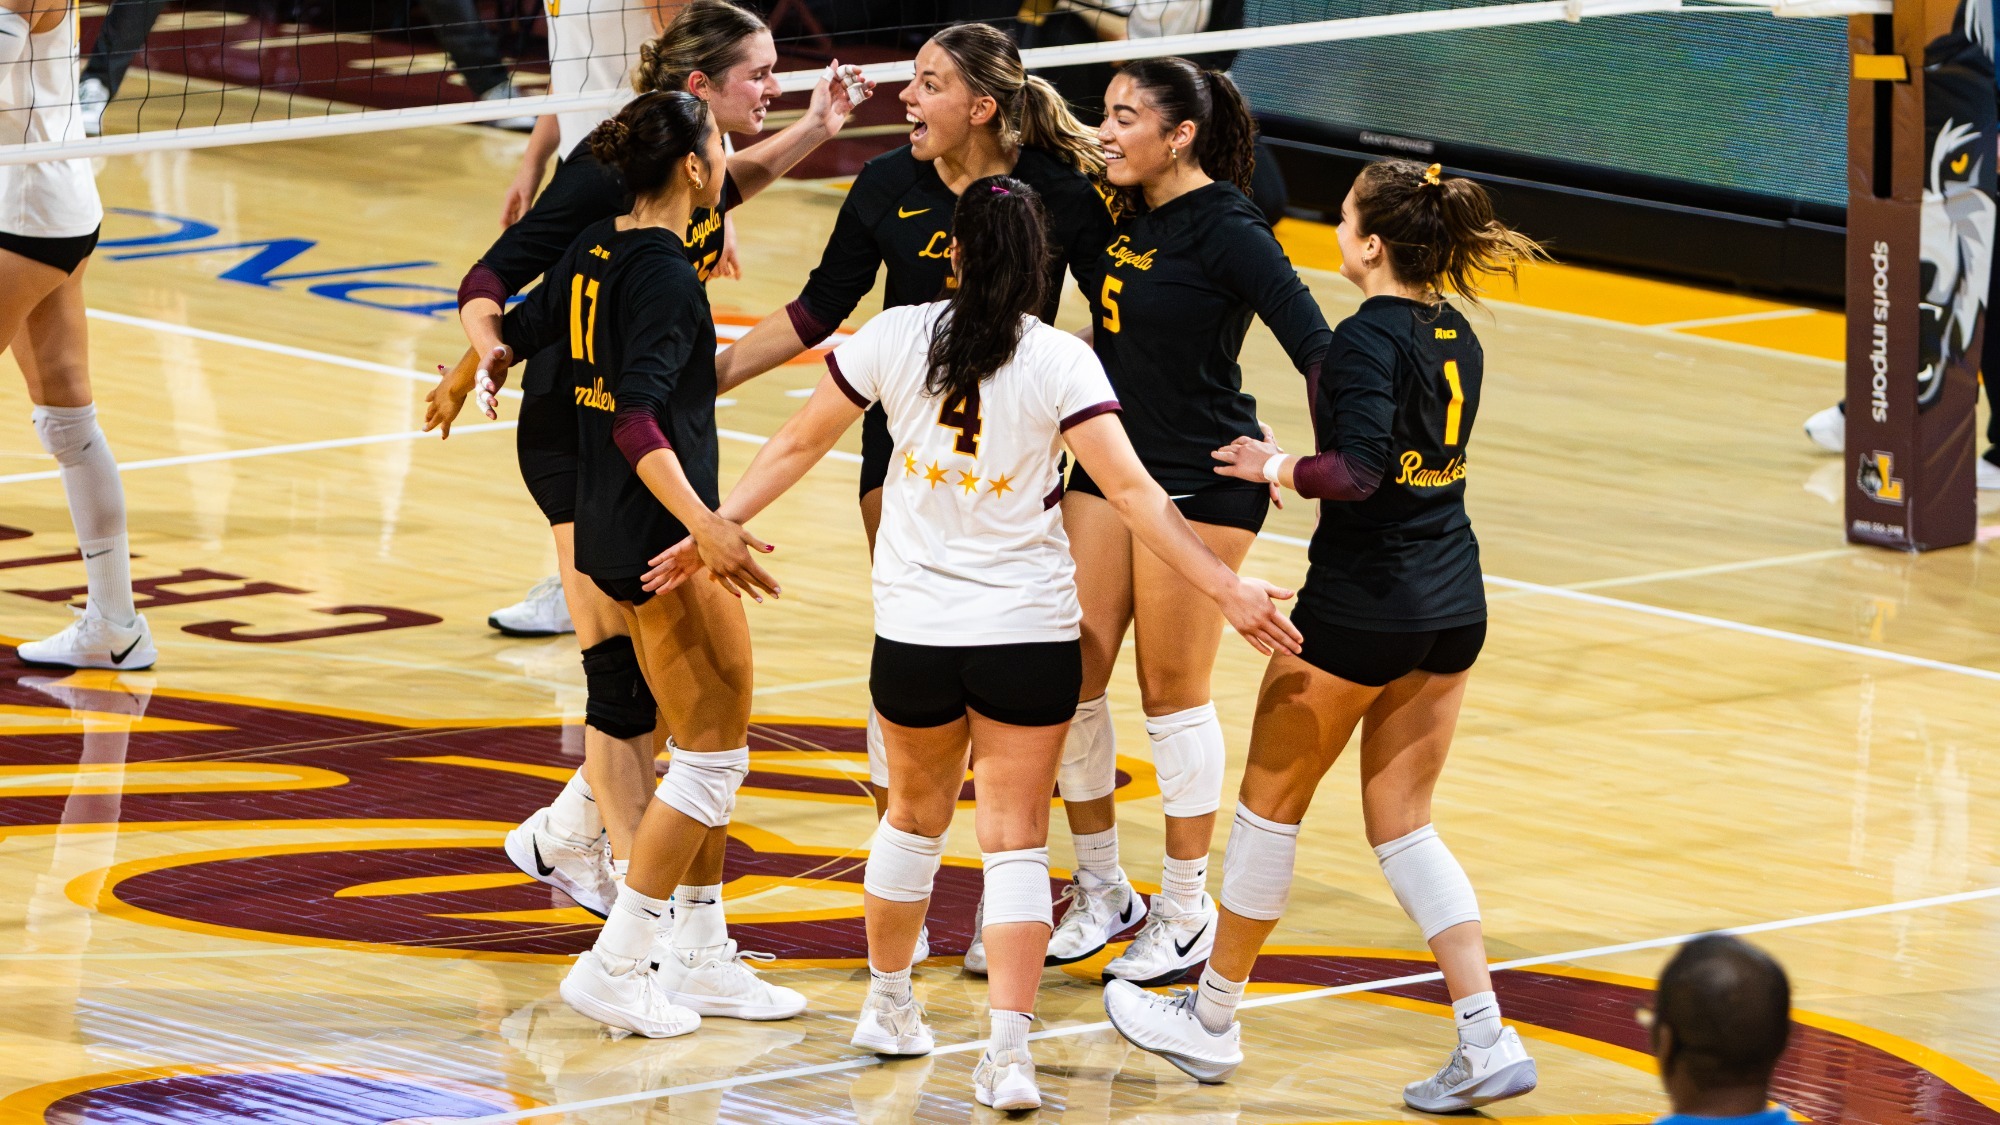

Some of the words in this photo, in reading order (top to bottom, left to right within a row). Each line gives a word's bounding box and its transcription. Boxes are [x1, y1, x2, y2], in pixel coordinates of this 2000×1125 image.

[1106, 235, 1157, 271] Loyola
[1870, 240, 1891, 321] sports
[1101, 273, 1123, 334] 5
[1443, 359, 1464, 445] 1
[1869, 324, 1889, 423] imports
[937, 376, 983, 460] 4
